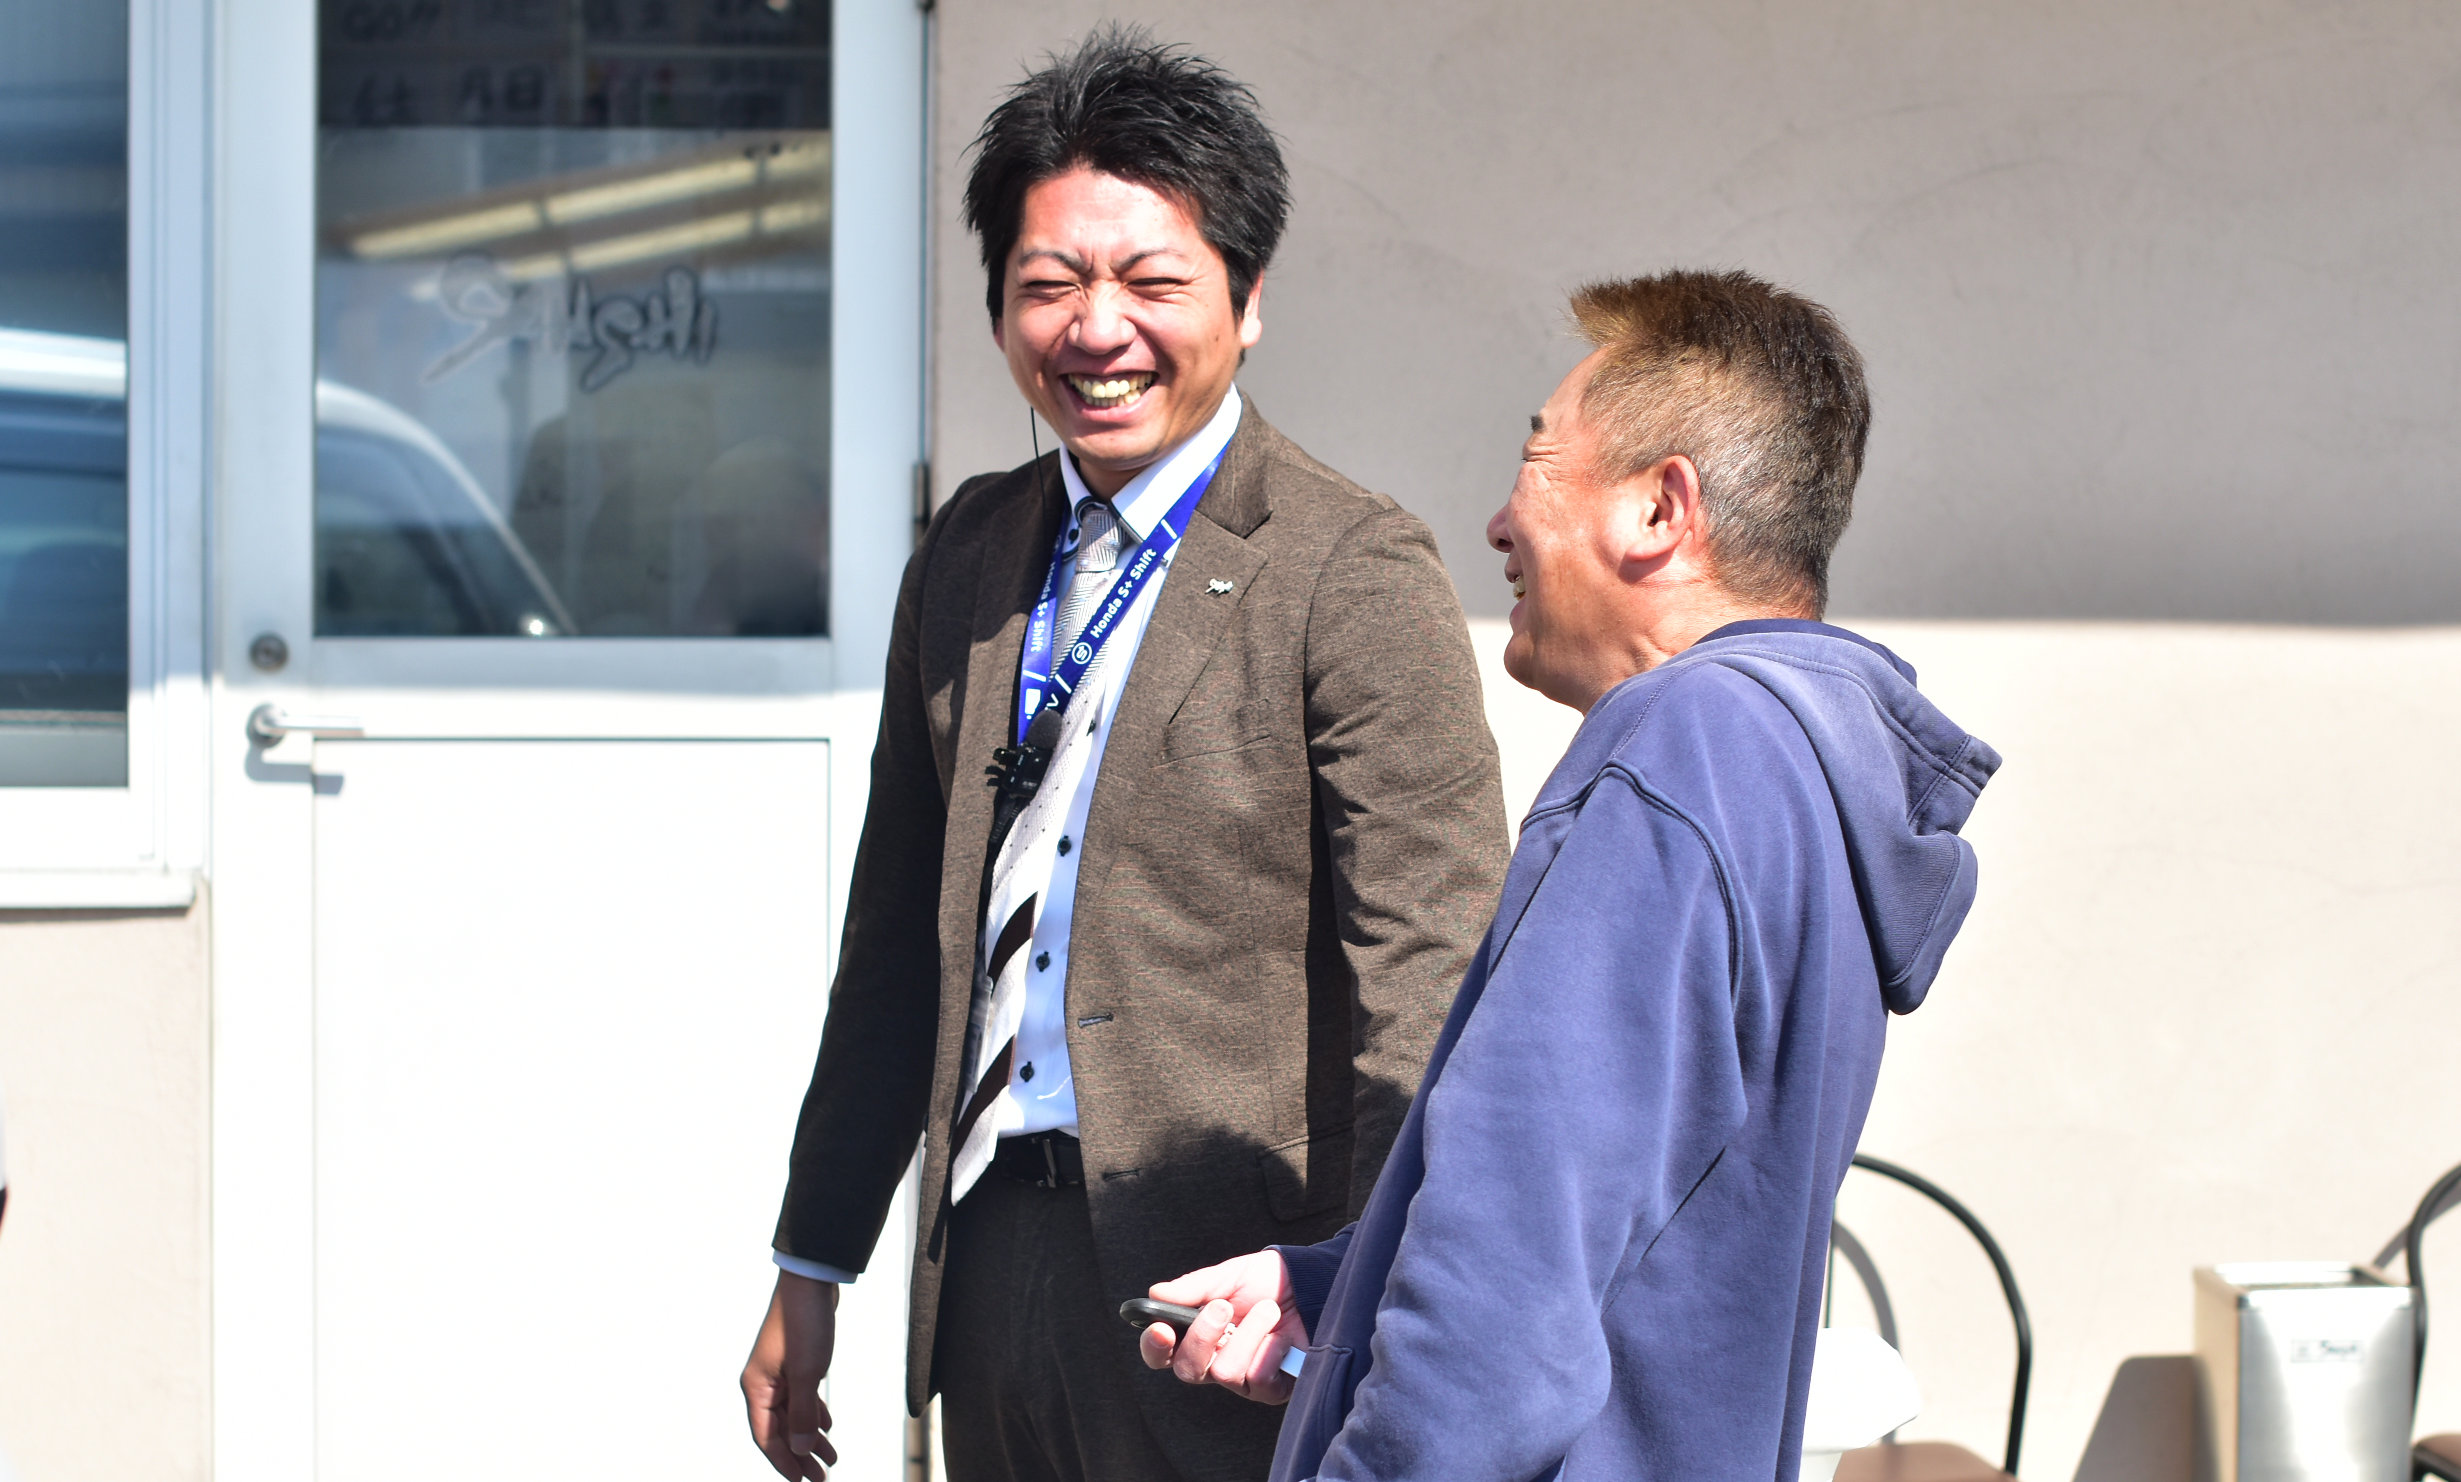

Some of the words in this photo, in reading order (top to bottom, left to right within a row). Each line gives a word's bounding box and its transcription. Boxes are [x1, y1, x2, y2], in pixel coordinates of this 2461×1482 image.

[1037, 601, 1049, 617] S+
[1089, 597, 1123, 639] Honda
[1117, 580, 1133, 598] S+
[1129, 548, 1157, 580] Shift
[1030, 620, 1046, 653] Shift
